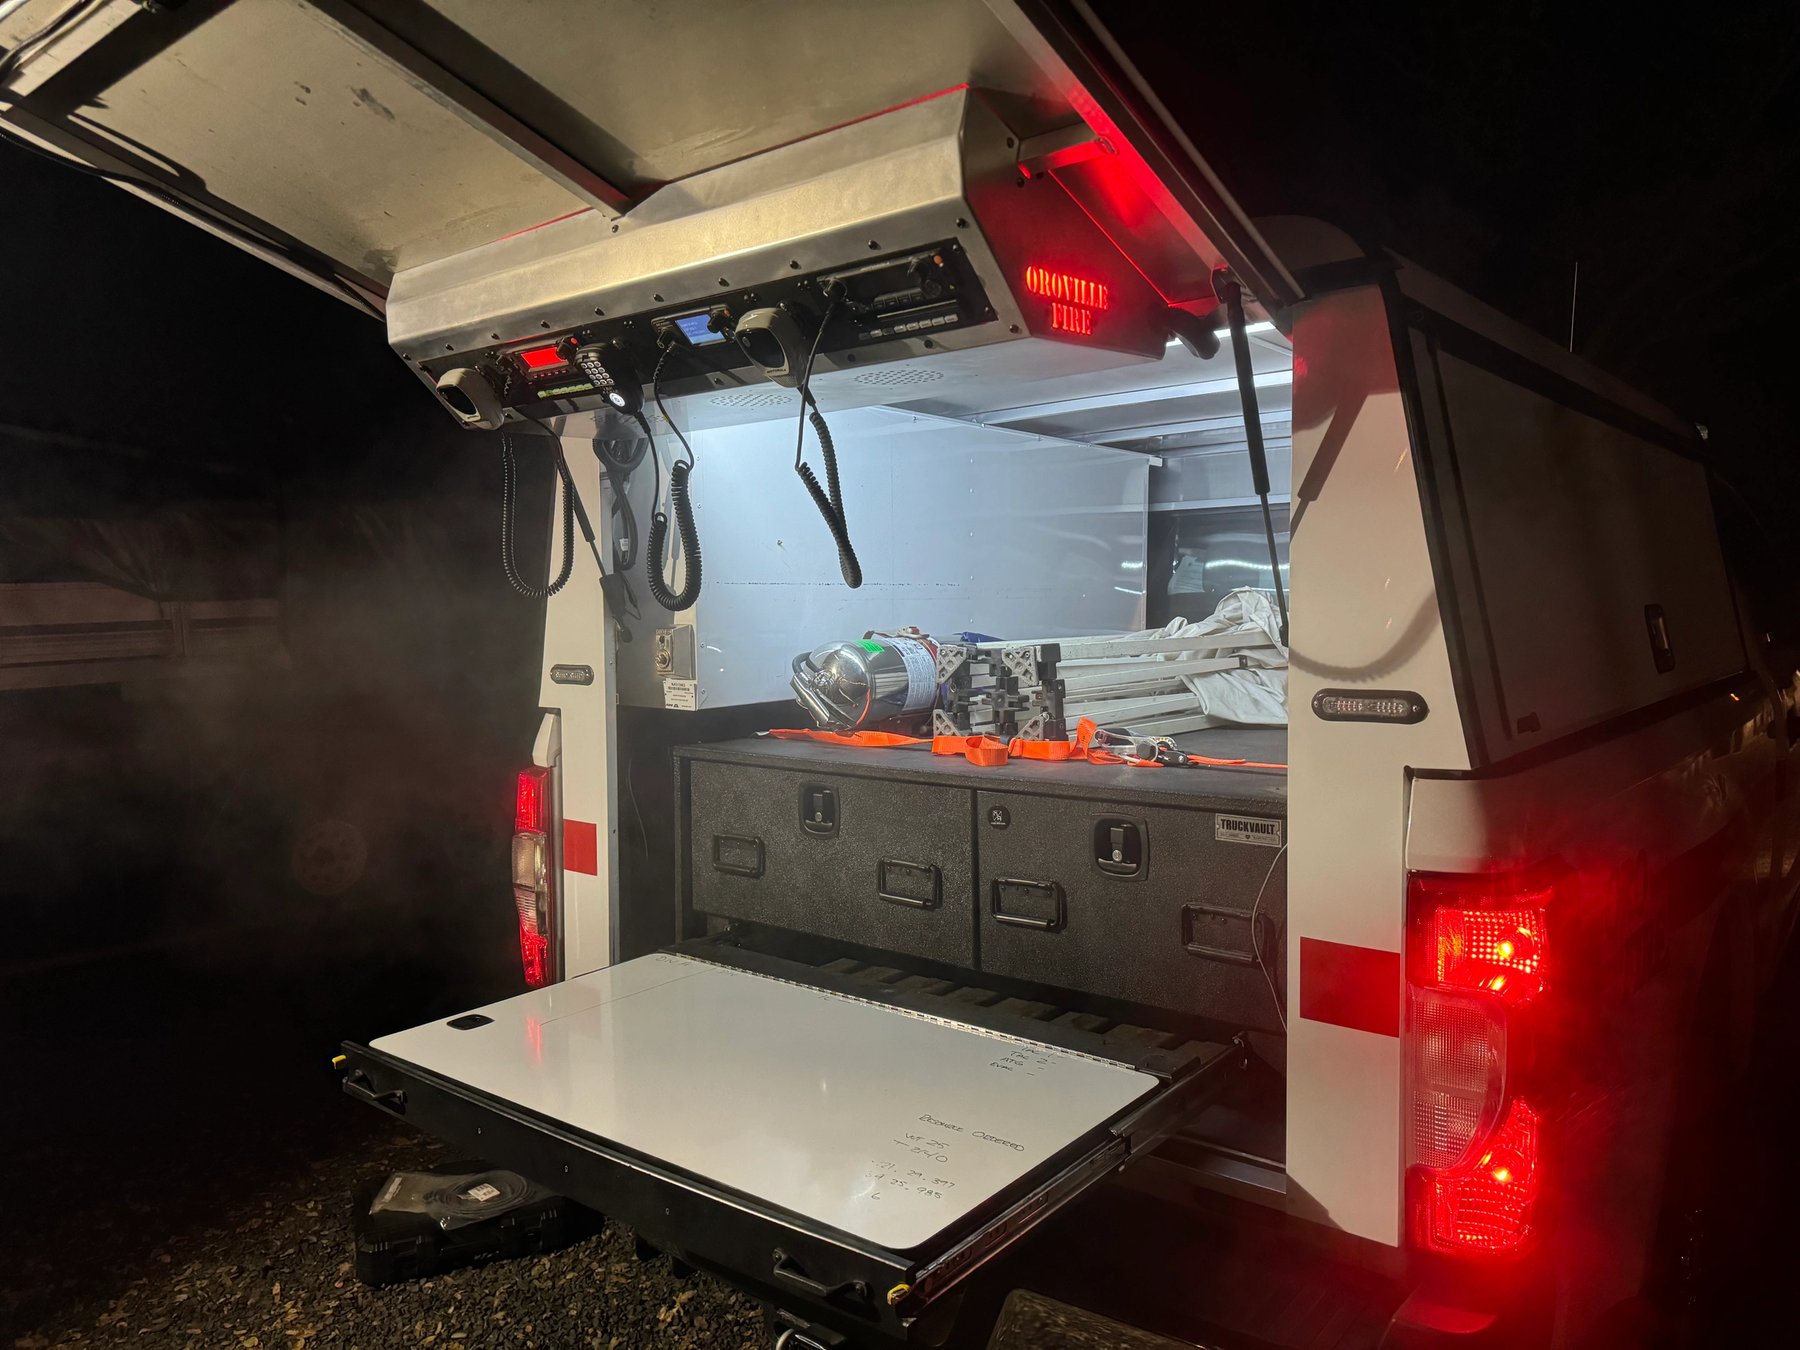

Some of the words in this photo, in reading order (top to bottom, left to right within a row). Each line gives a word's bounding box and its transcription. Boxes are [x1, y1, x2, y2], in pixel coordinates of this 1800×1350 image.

[1026, 266, 1108, 310] OROVILLE
[1051, 302, 1092, 335] FIRE
[1220, 819, 1275, 835] TRUCKVAULT
